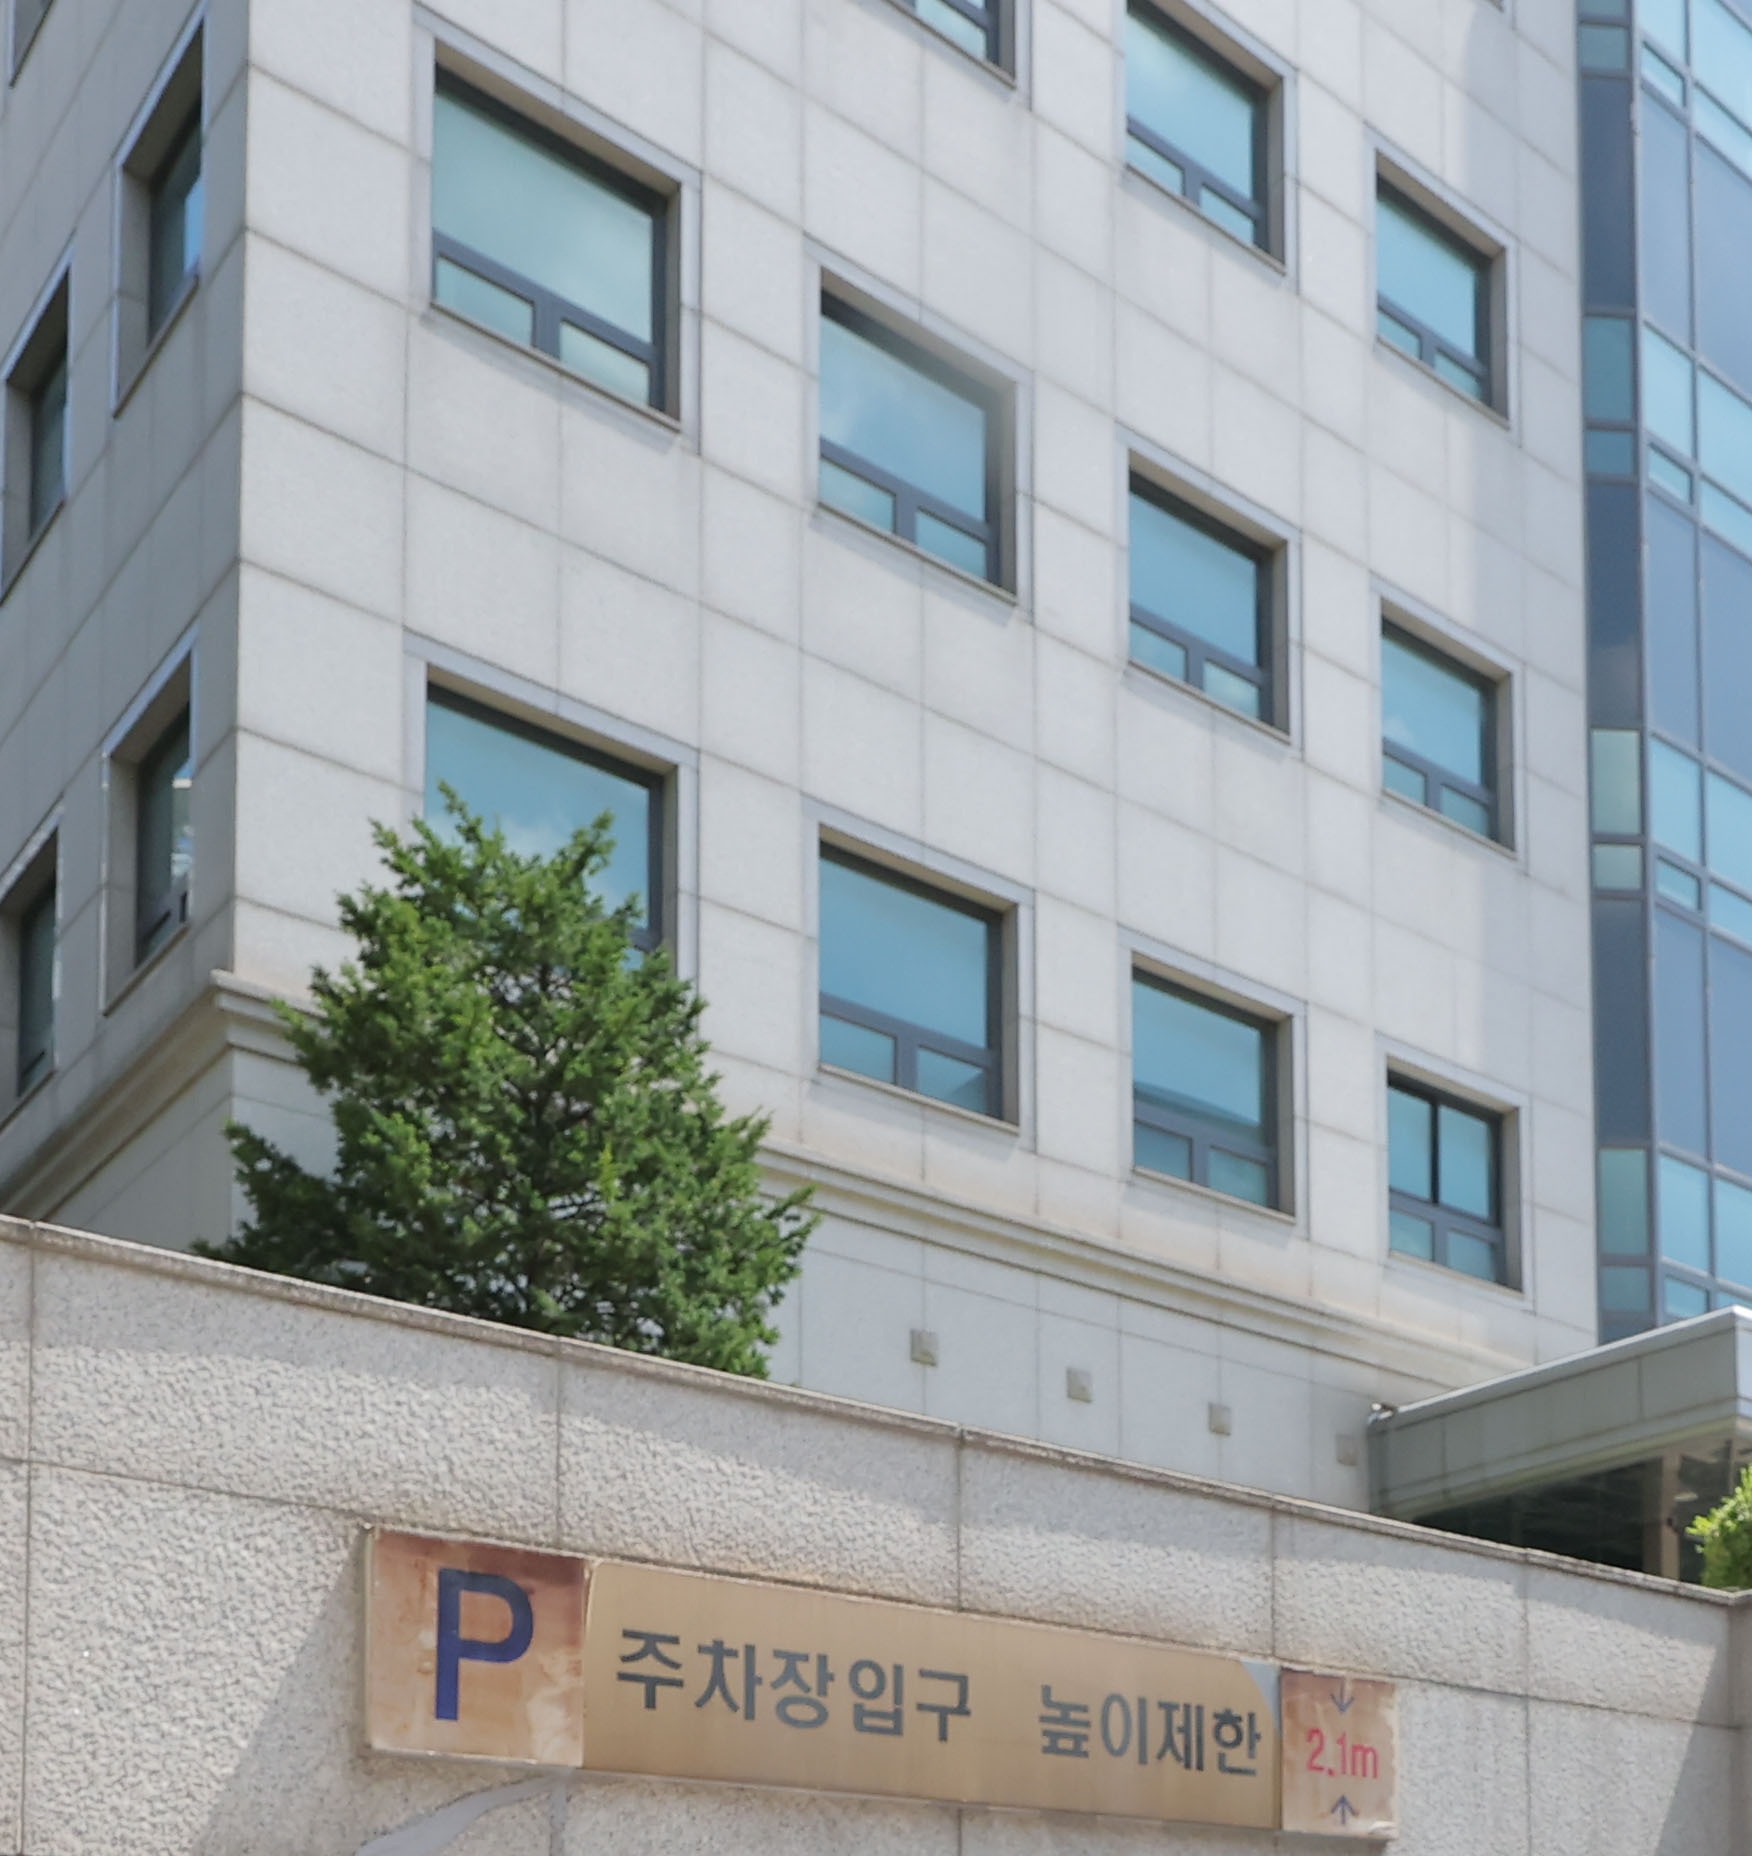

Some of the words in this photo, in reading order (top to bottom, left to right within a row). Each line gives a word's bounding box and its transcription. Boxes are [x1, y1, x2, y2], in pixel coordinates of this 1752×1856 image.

[436, 1568, 534, 1722] P
[617, 1629, 972, 1743] 주차장입구
[1038, 1684, 1261, 1777] 높이제한
[1305, 1728, 1379, 1779] 2.1m
